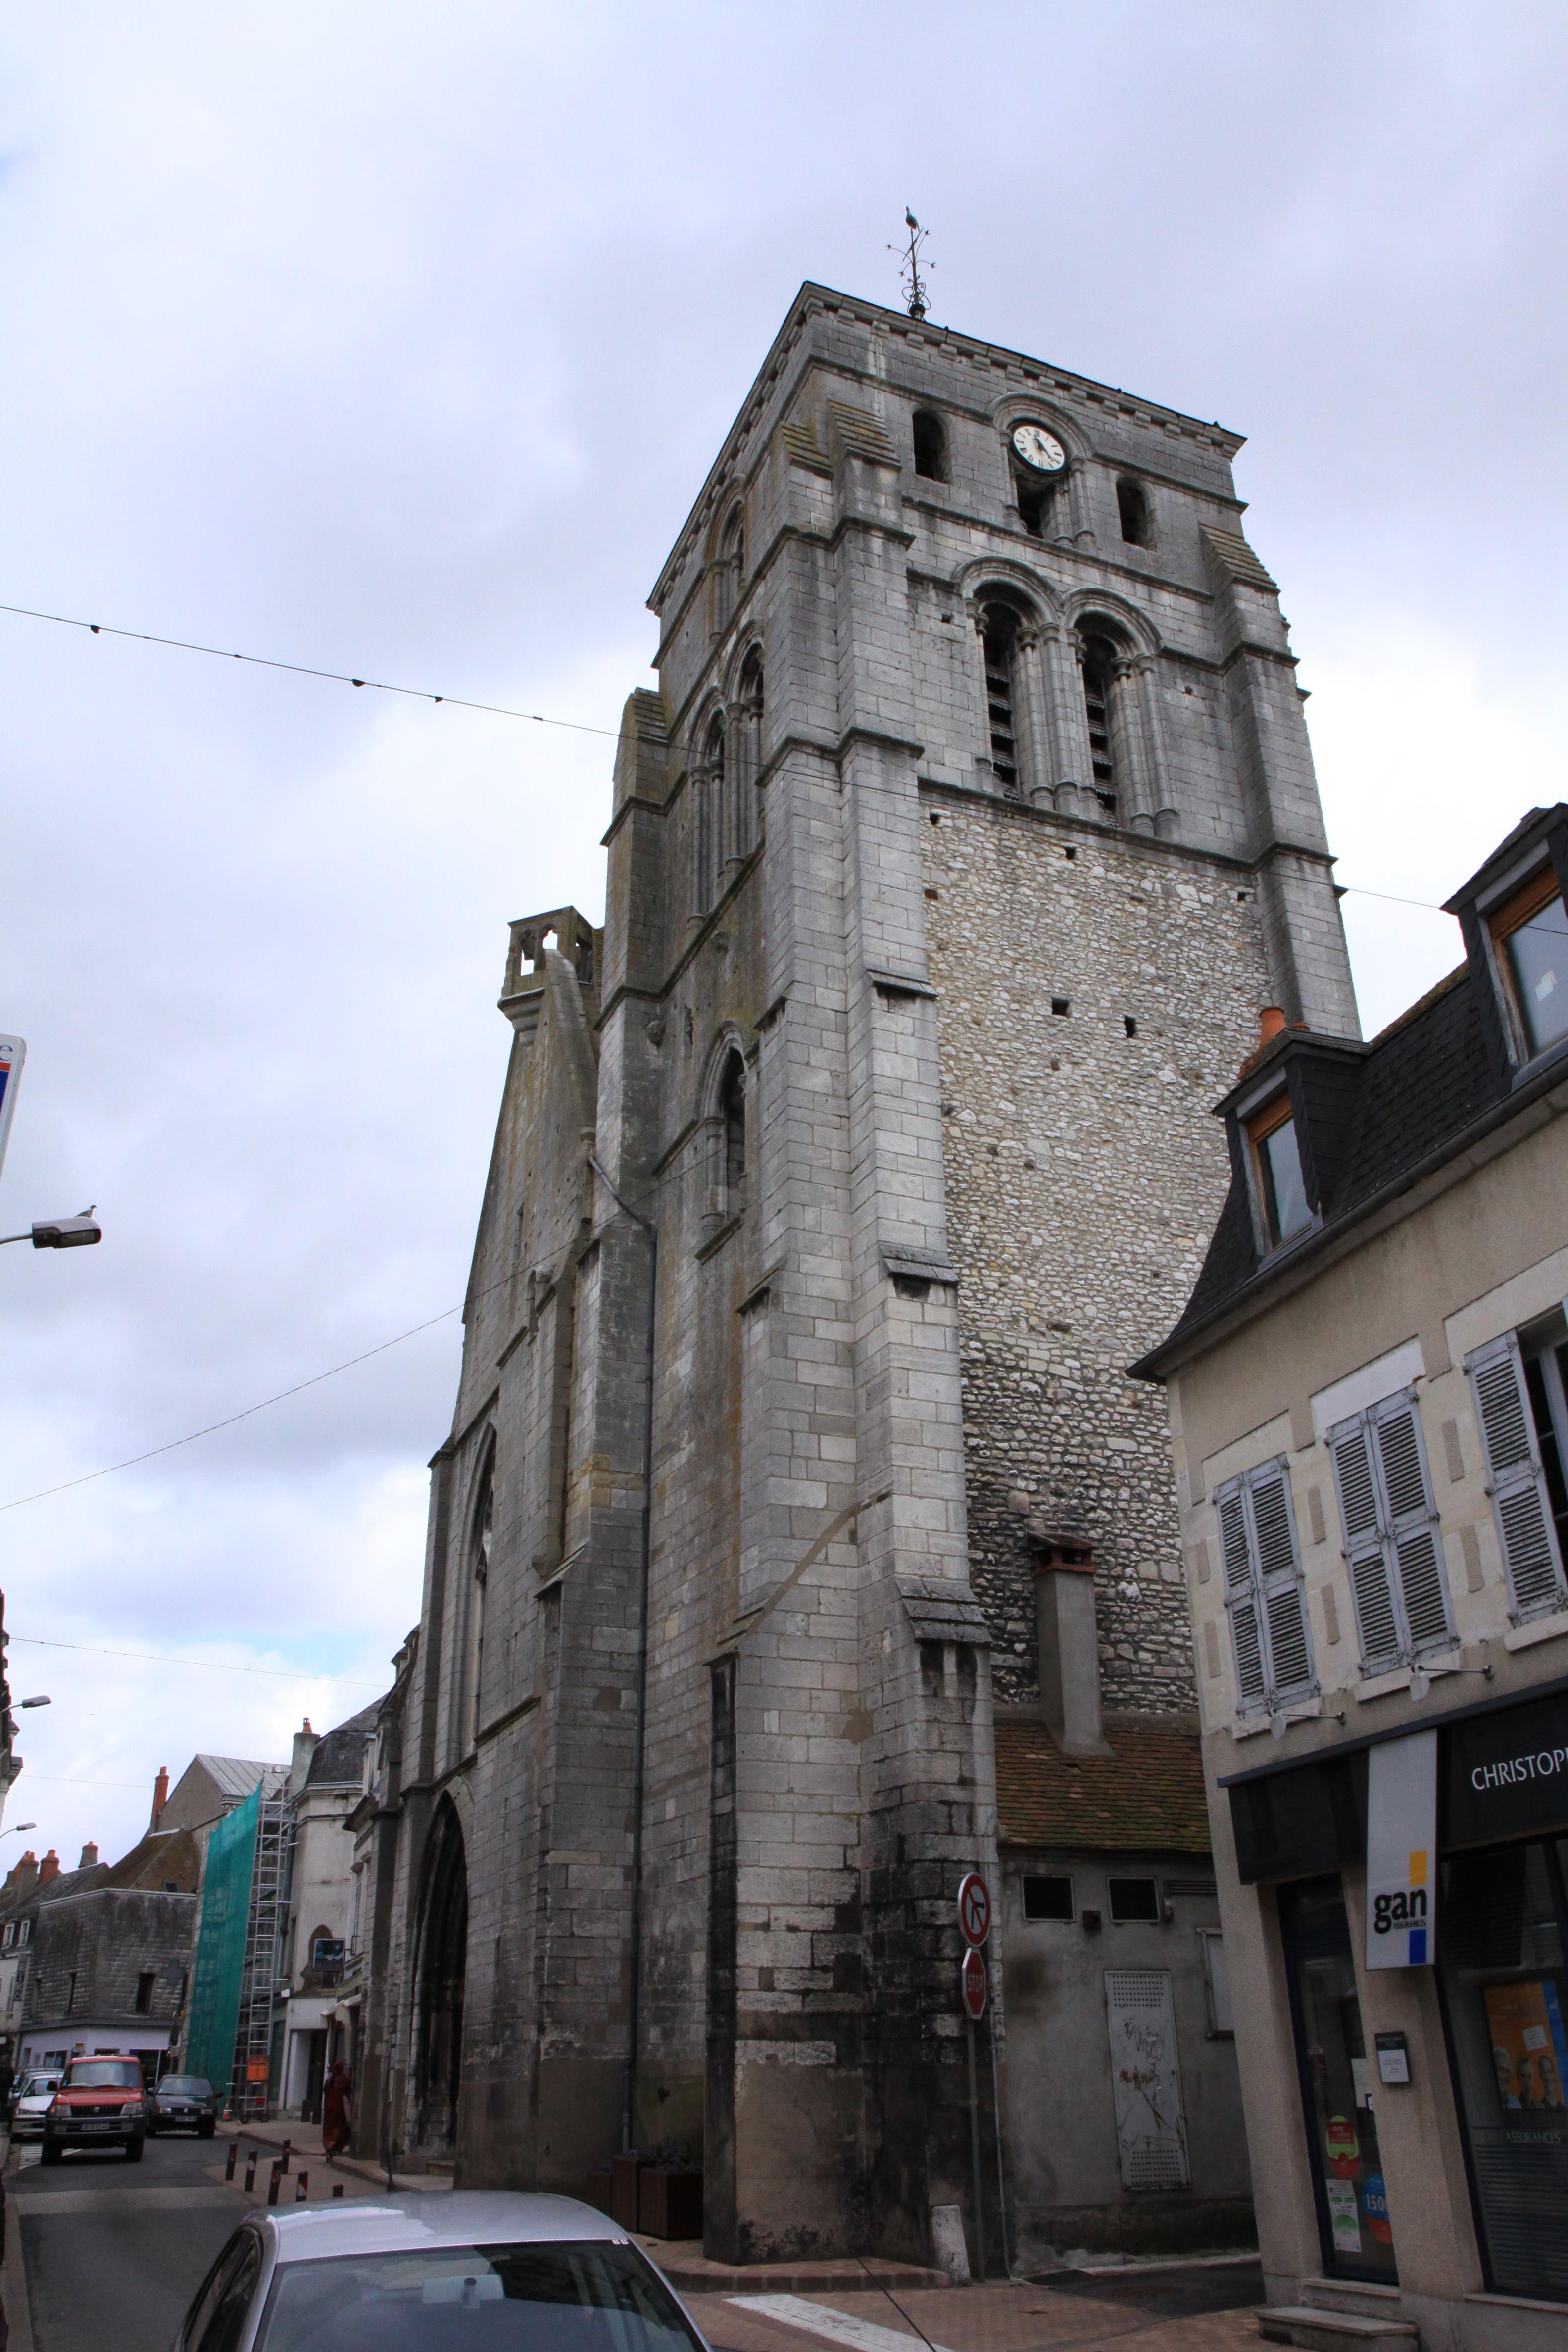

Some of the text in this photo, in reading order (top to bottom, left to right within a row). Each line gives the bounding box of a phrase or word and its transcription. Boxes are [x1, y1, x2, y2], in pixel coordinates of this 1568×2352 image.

[1374, 1888, 1427, 1934] gan
[1393, 1919, 1426, 1930] ASSURANCES
[15, 1955, 27, 2000] SEIKO
[968, 1974, 983, 1993] STOP
[1506, 2132, 1561, 2143] ASSURANCES
